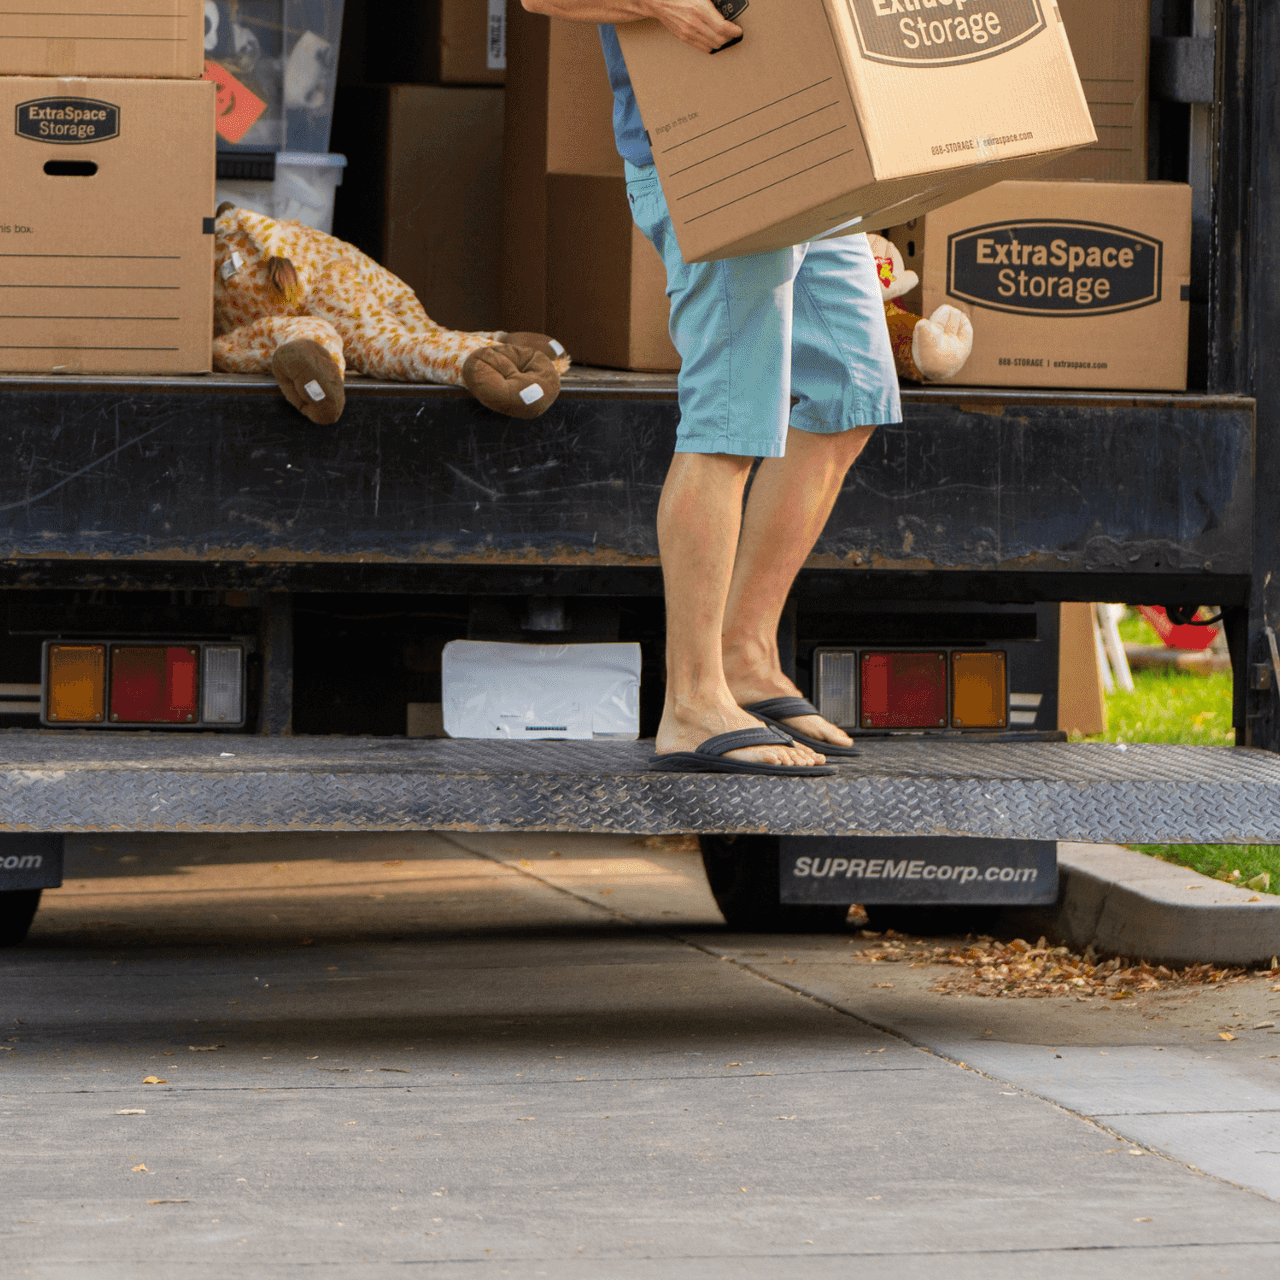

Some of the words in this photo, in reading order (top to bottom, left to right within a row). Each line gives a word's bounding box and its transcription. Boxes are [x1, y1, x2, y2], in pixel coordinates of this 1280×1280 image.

[898, 10, 1002, 49] Storage
[29, 106, 107, 123] ExtraSpace
[39, 121, 95, 139] Storage
[976, 238, 1135, 272] ExtraSpace
[997, 268, 1111, 304] Storage
[998, 357, 1044, 368] 888-STORAGE
[1053, 359, 1108, 370] extraspace.com
[793, 856, 1039, 884] SUPREMEcorp.com
